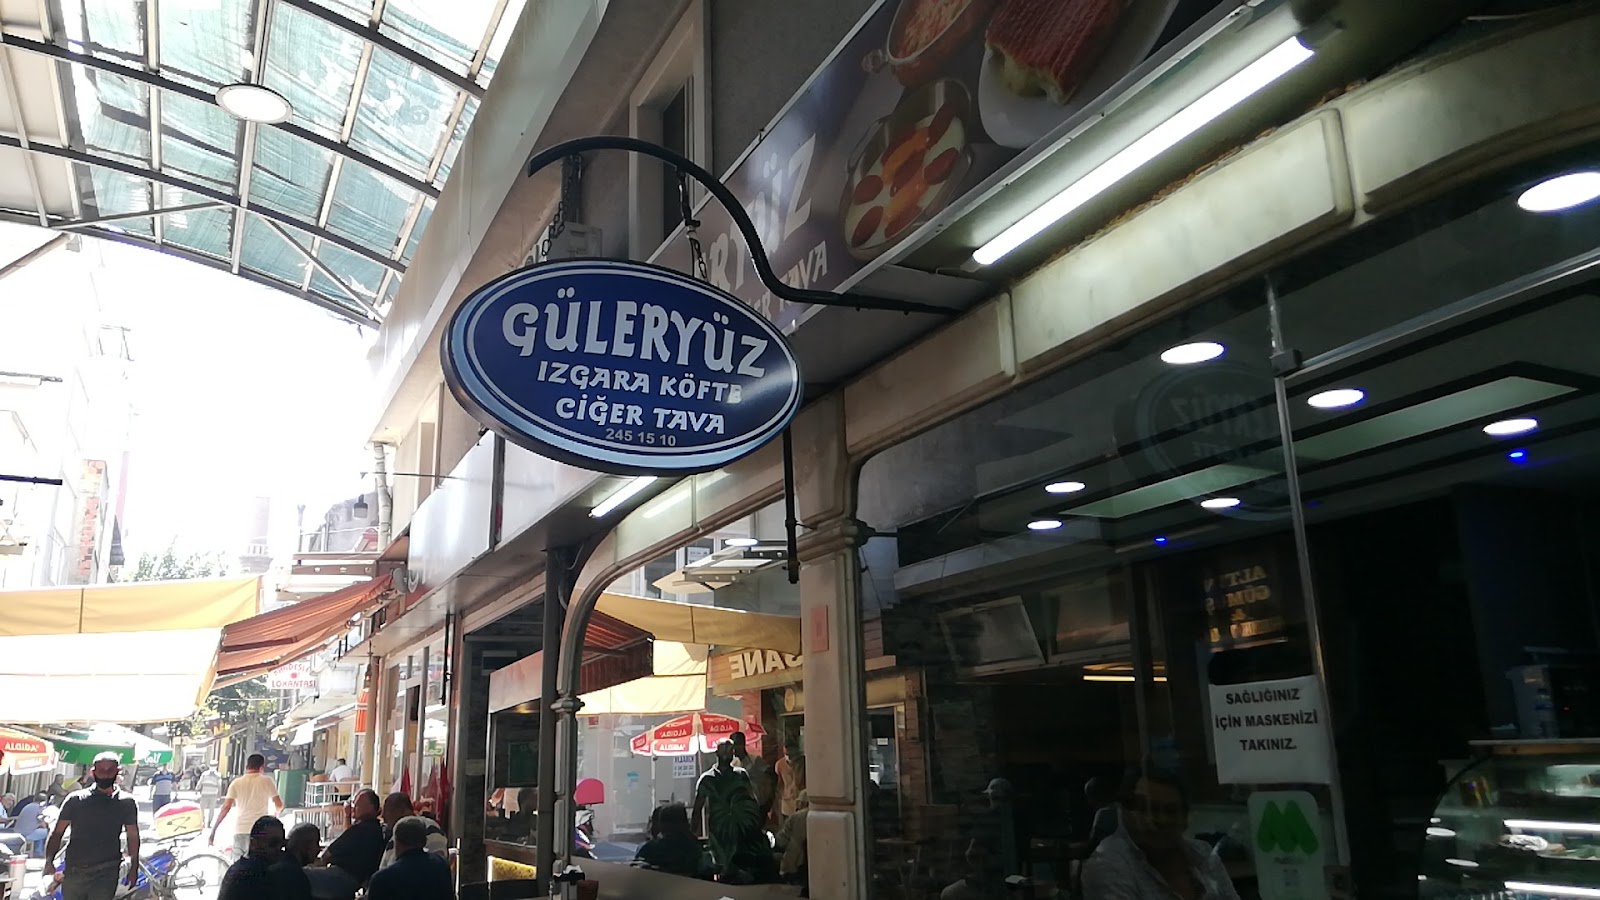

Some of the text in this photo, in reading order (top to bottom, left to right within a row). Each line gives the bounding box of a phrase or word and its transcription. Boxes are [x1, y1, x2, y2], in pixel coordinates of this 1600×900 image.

[502, 286, 769, 379] GÜLERYÜZ
[537, 360, 743, 404] IZGARA KÖFTE
[555, 393, 725, 435] CİĞER TAVA
[605, 428, 677, 447] 245 15 10
[271, 679, 316, 688] LOKANTASI
[1225, 688, 1300, 705] SAĞLIĞINIZ
[1215, 708, 1318, 731] İÇİN MASKENİZİ
[4, 741, 38, 752] ALGIDA
[1239, 738, 1297, 751] TAKINIZ.
